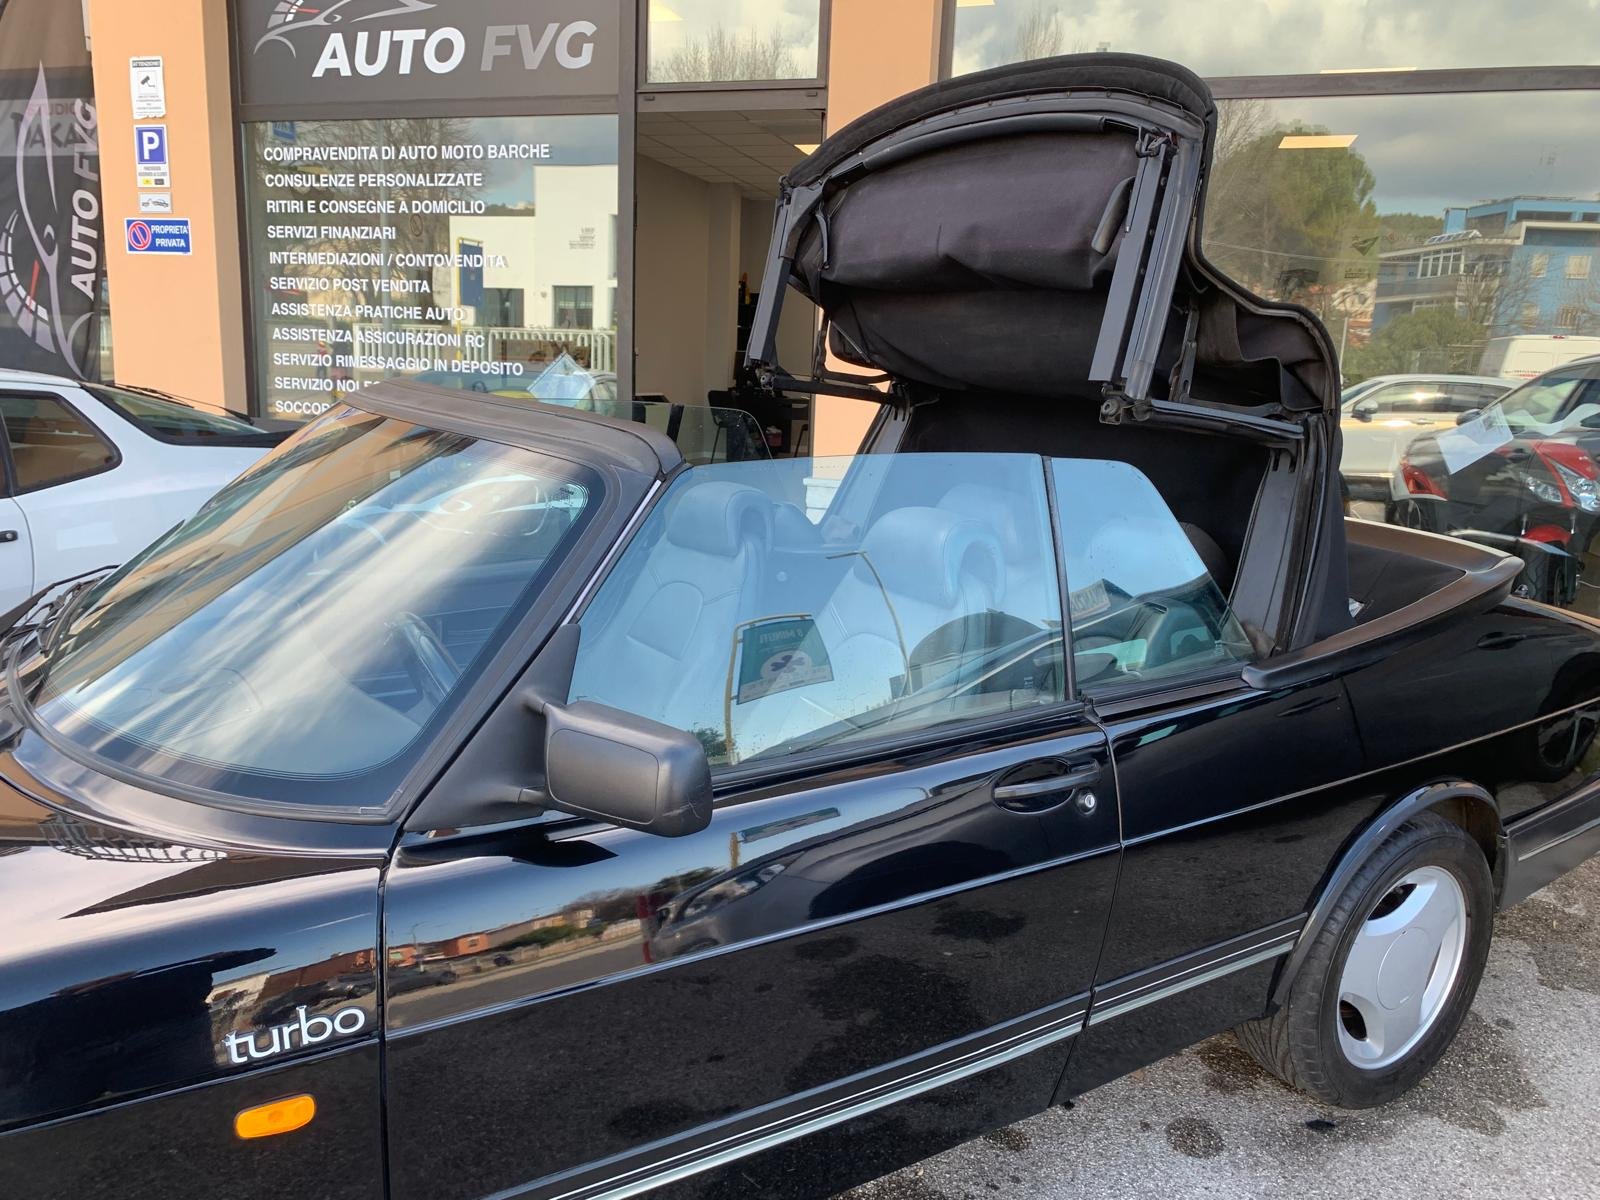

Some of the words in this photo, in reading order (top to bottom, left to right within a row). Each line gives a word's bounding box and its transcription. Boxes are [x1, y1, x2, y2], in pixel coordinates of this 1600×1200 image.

[312, 26, 465, 78] AUTO
[480, 20, 598, 72] FVG
[73, 98, 99, 182] FVG
[142, 131, 160, 160] P
[264, 146, 378, 161] COMPRAVENDITA
[382, 146, 395, 160] DI
[398, 146, 437, 160] AUTO
[442, 144, 483, 159] MOTO
[488, 144, 550, 158] BARCHE
[265, 174, 355, 188] CONSULENZE
[358, 173, 482, 187] PERSONALIZZATE
[266, 200, 304, 213] RITIRI
[307, 200, 316, 213] E
[320, 200, 395, 214] CONSEGNE
[398, 201, 408, 214] A
[412, 200, 485, 214] DOMICILIO
[267, 225, 317, 238] SERVIZI
[321, 226, 396, 240] FINANZIARI
[70, 188, 99, 302] AUTO
[156, 238, 186, 248] PRIVATA
[270, 252, 384, 266] INTERMEDIAZIONI
[387, 252, 392, 266] /
[396, 253, 505, 268] CONTOVENDITA
[270, 276, 329, 291] SERVIZIO
[333, 278, 368, 292] POST
[373, 280, 430, 294] VENDITA
[271, 302, 352, 317] ASSISTENZA
[355, 305, 422, 320] PRATICHE
[426, 307, 465, 321] AUTO
[272, 328, 353, 342] ASSISTENZA
[356, 330, 460, 347] ASSICURAZIONI
[465, 334, 485, 348] RC
[274, 353, 332, 367] SERVIZIO
[335, 354, 430, 371] RIMESSAGGIO
[434, 358, 447, 372] IN
[451, 360, 524, 376] DEPOSITO
[274, 377, 333, 391] SERVIZIO
[222, 1004, 366, 1064] turbo
